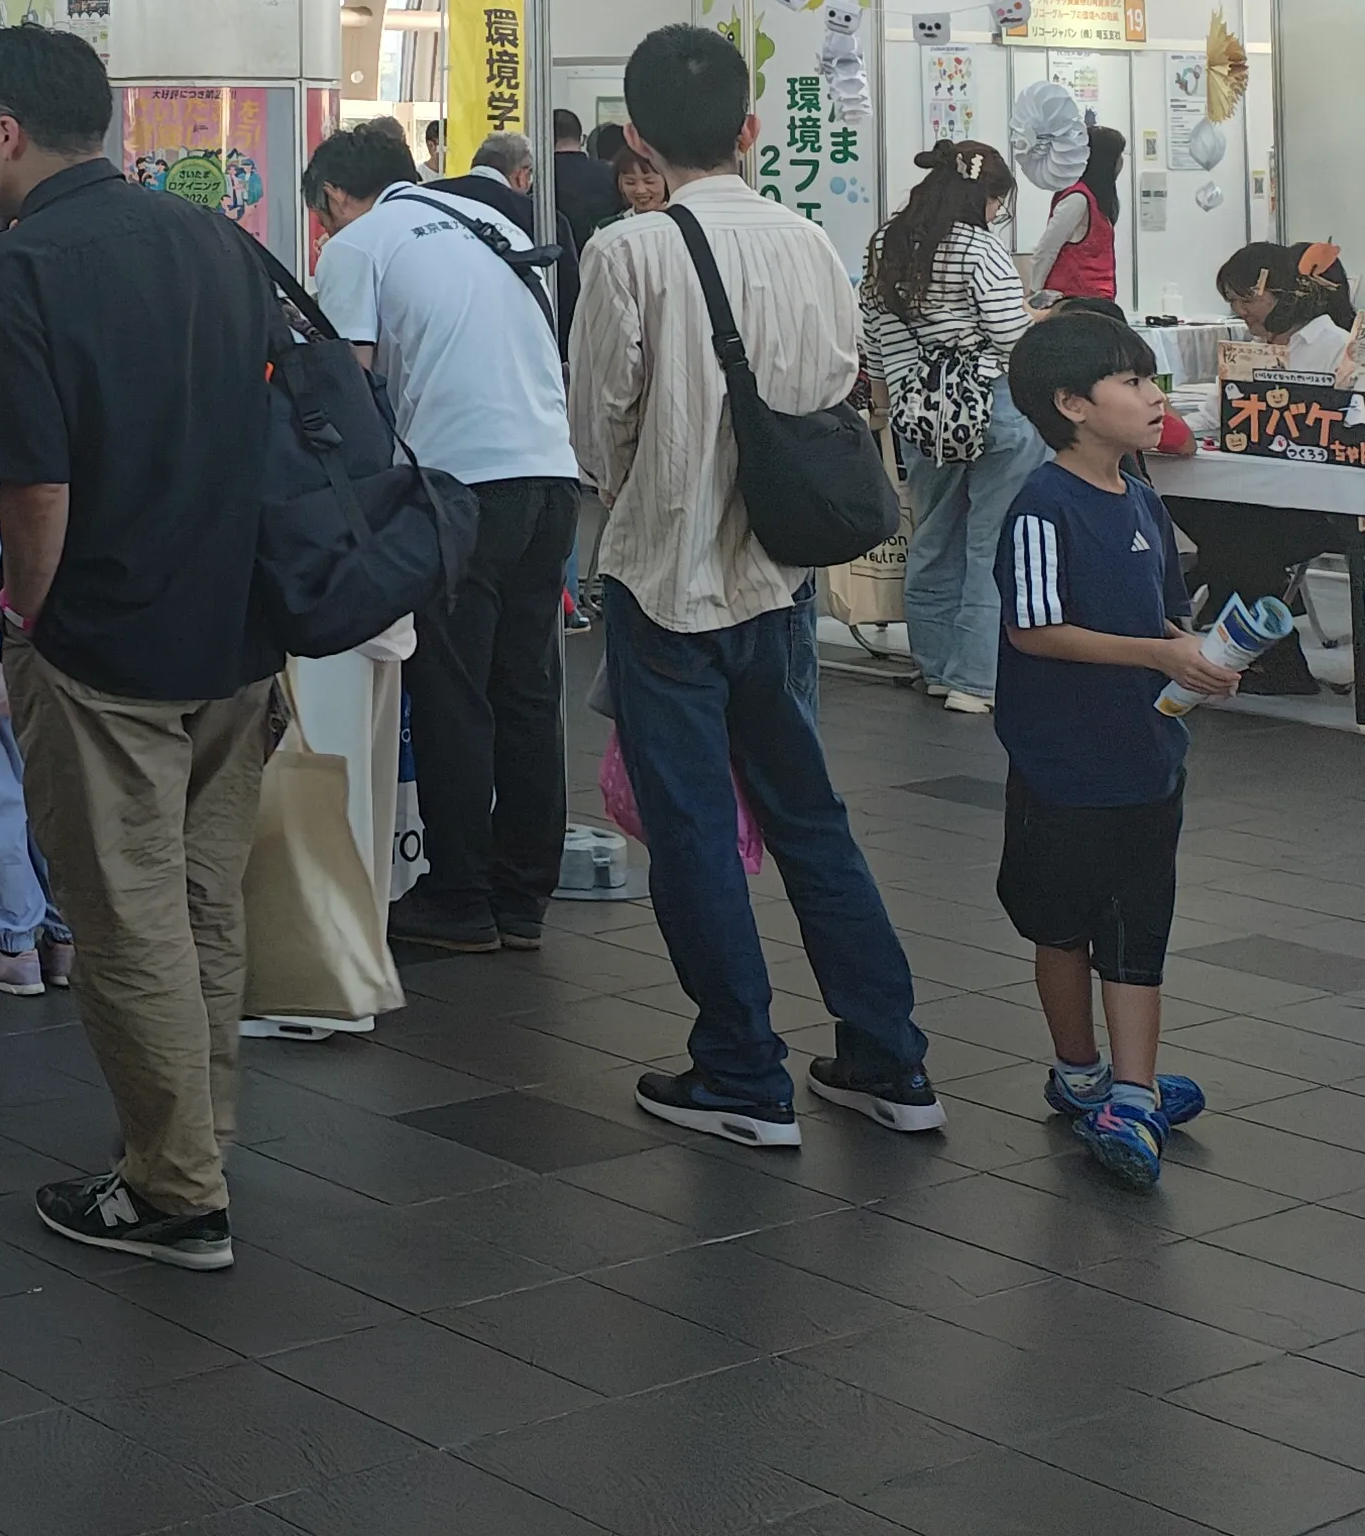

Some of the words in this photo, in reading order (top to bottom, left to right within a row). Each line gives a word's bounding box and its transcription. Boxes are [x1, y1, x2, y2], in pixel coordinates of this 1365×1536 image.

[1126, 8, 1144, 31] 19
[483, 8, 520, 131] 環境学
[179, 170, 210, 179] さいたま
[168, 181, 221, 191] ロゲイニング
[1227, 394, 1344, 446] オバケ
[1288, 448, 1327, 460] つくろう
